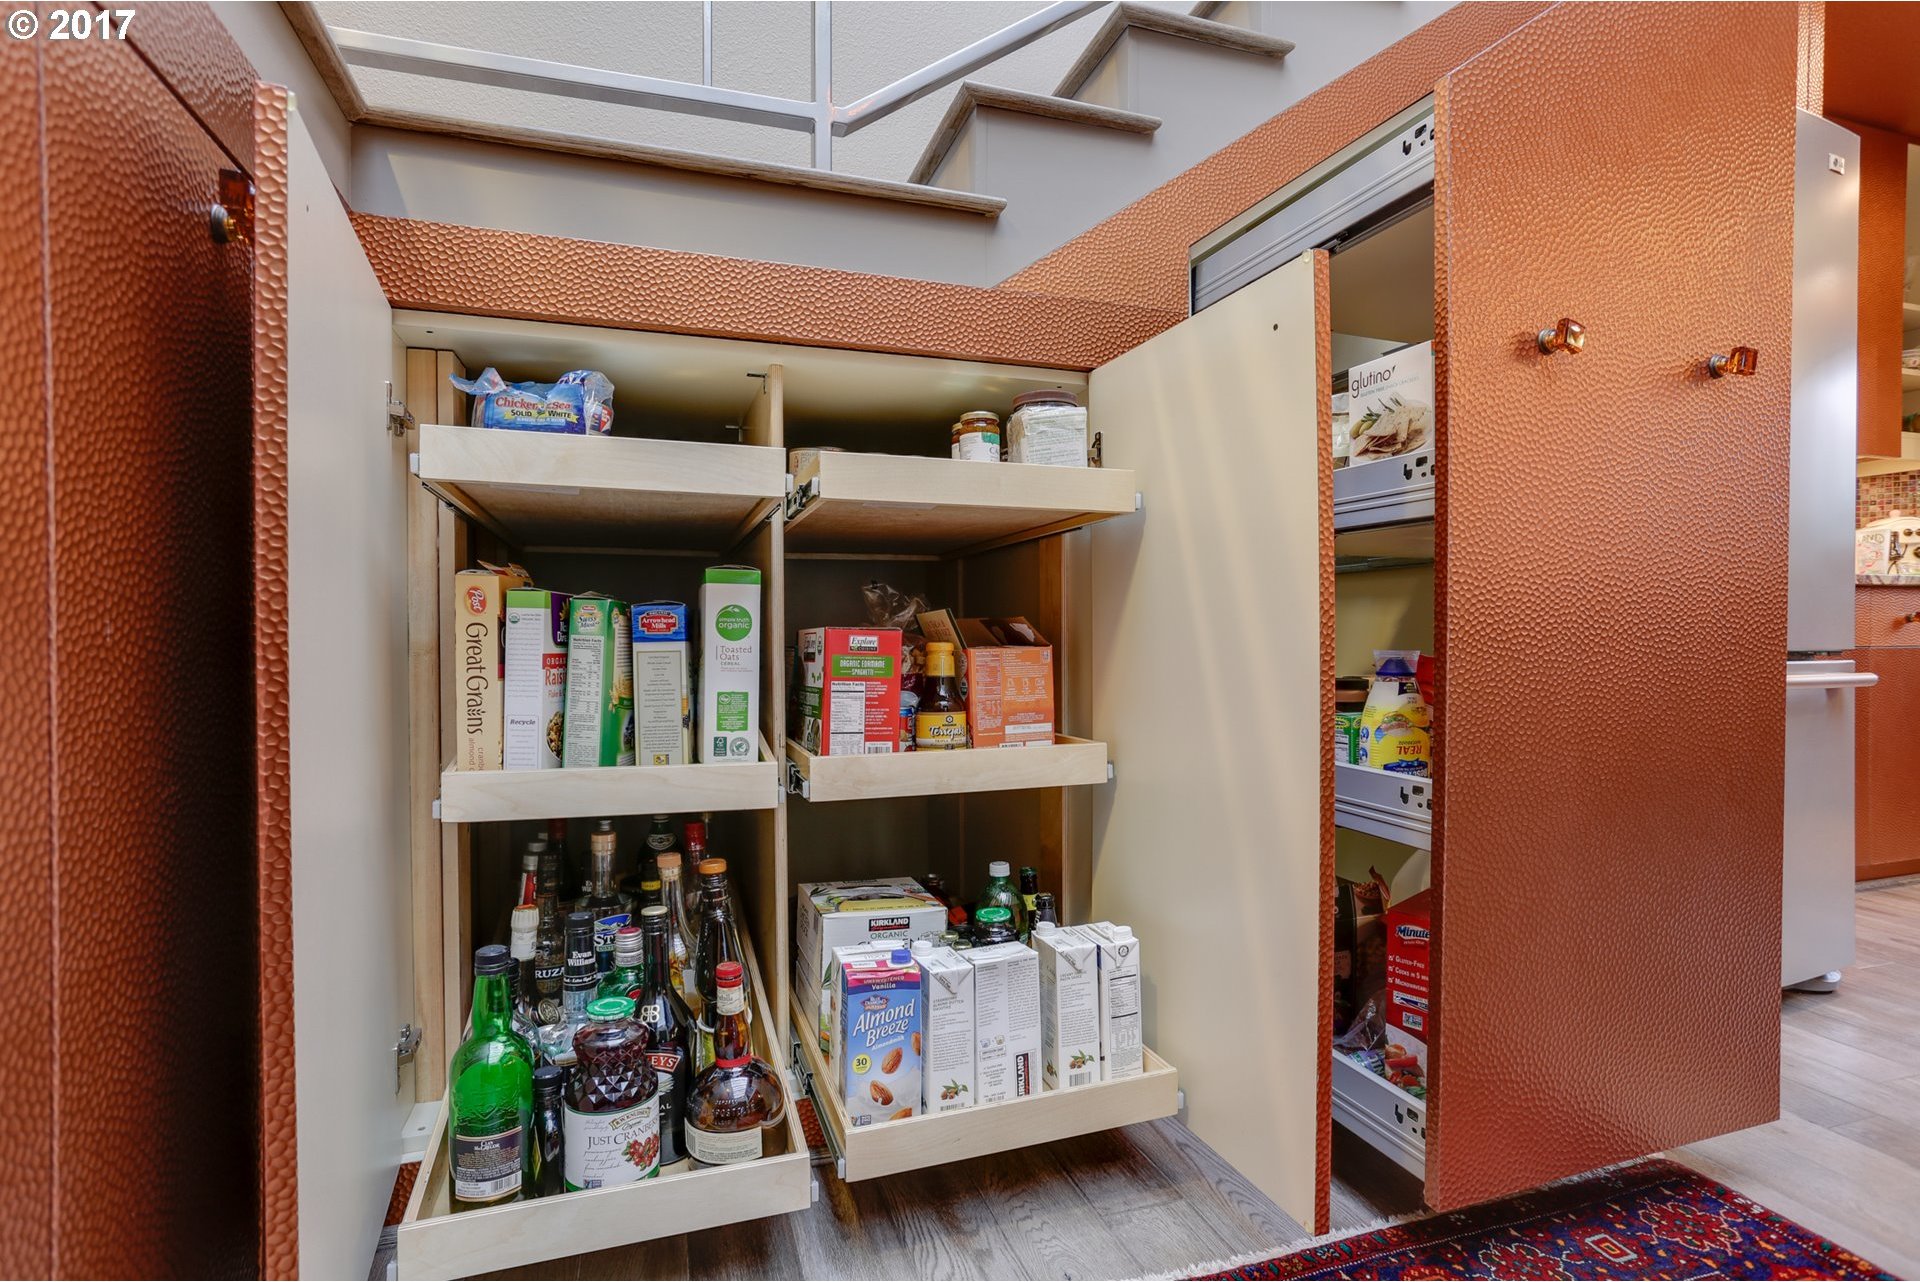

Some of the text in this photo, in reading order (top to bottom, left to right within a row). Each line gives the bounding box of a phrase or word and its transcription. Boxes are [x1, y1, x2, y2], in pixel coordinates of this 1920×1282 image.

[1351, 369, 1392, 399] glutino
[469, 588, 483, 613] Post
[718, 621, 750, 630] organic
[852, 637, 876, 646] Explore
[720, 645, 753, 654] Toasted
[720, 653, 740, 661] Oats
[465, 622, 489, 736] Great Grains
[510, 718, 536, 726] Recycle
[1397, 745, 1422, 755] REAL
[870, 918, 909, 927] KIRKLAND
[870, 930, 909, 940] ORGANIC
[1396, 925, 1430, 939] Minute
[572, 950, 592, 959] Evan
[852, 998, 915, 1037] Almond
[866, 1018, 909, 1048] Breeze
[855, 1057, 868, 1067] 30
[587, 1135, 613, 1150] JUST
